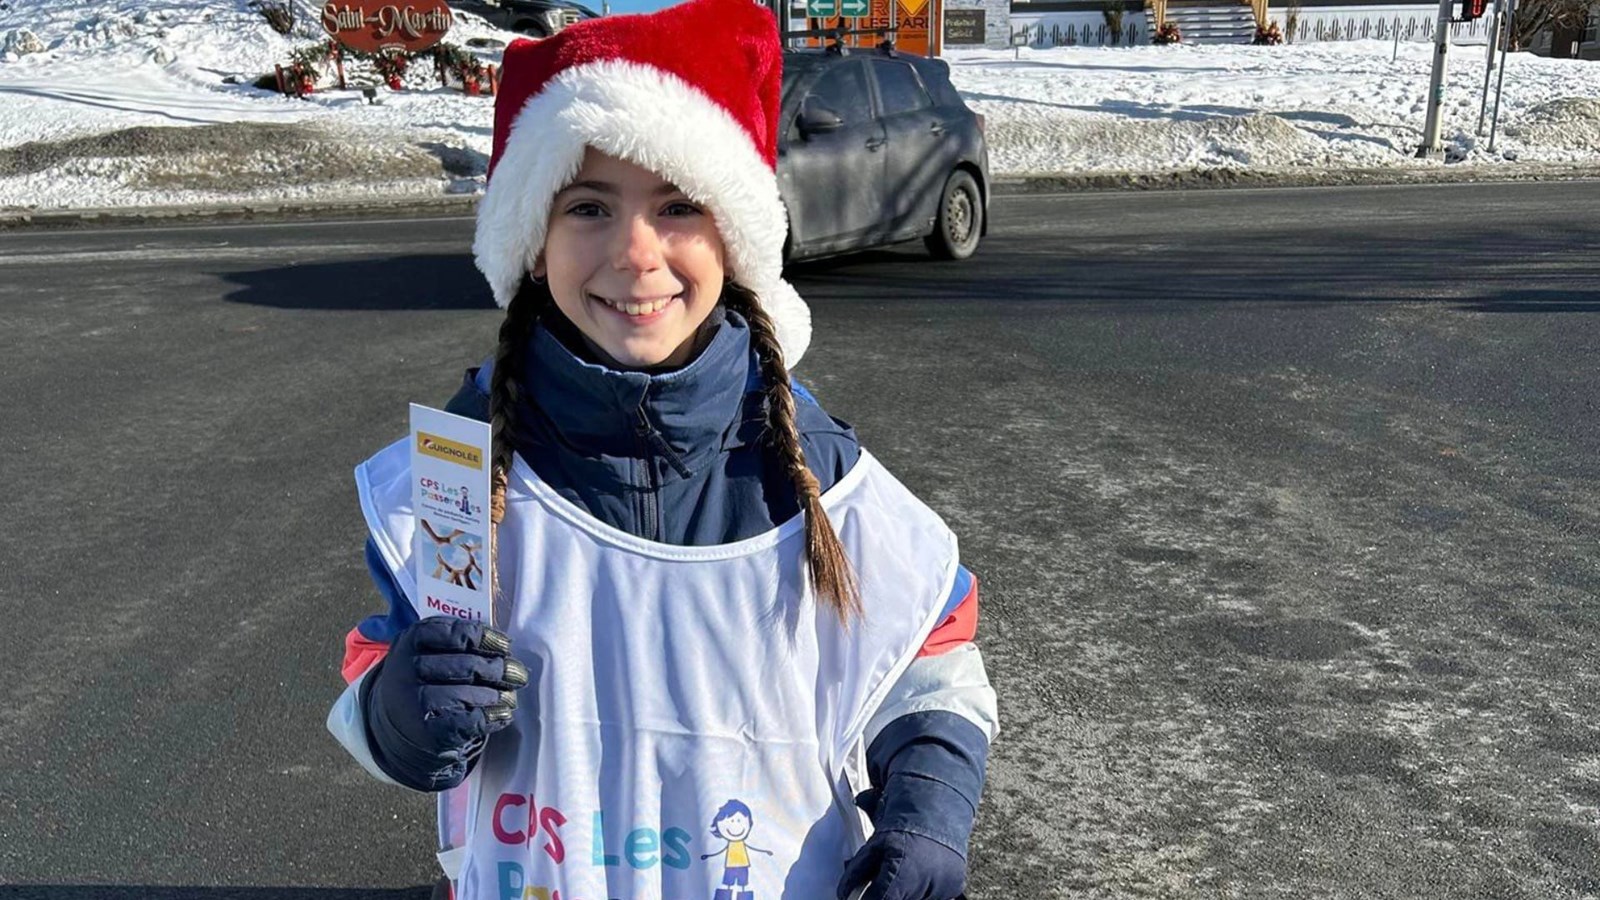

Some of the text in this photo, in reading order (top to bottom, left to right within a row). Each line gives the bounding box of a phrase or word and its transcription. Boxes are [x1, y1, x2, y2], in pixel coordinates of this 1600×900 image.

[323, 3, 451, 38] Saint-Martin
[861, 17, 930, 29] LESAR
[420, 478, 459, 496] CPS Les
[427, 595, 472, 620] Merci
[592, 810, 692, 870] Les
